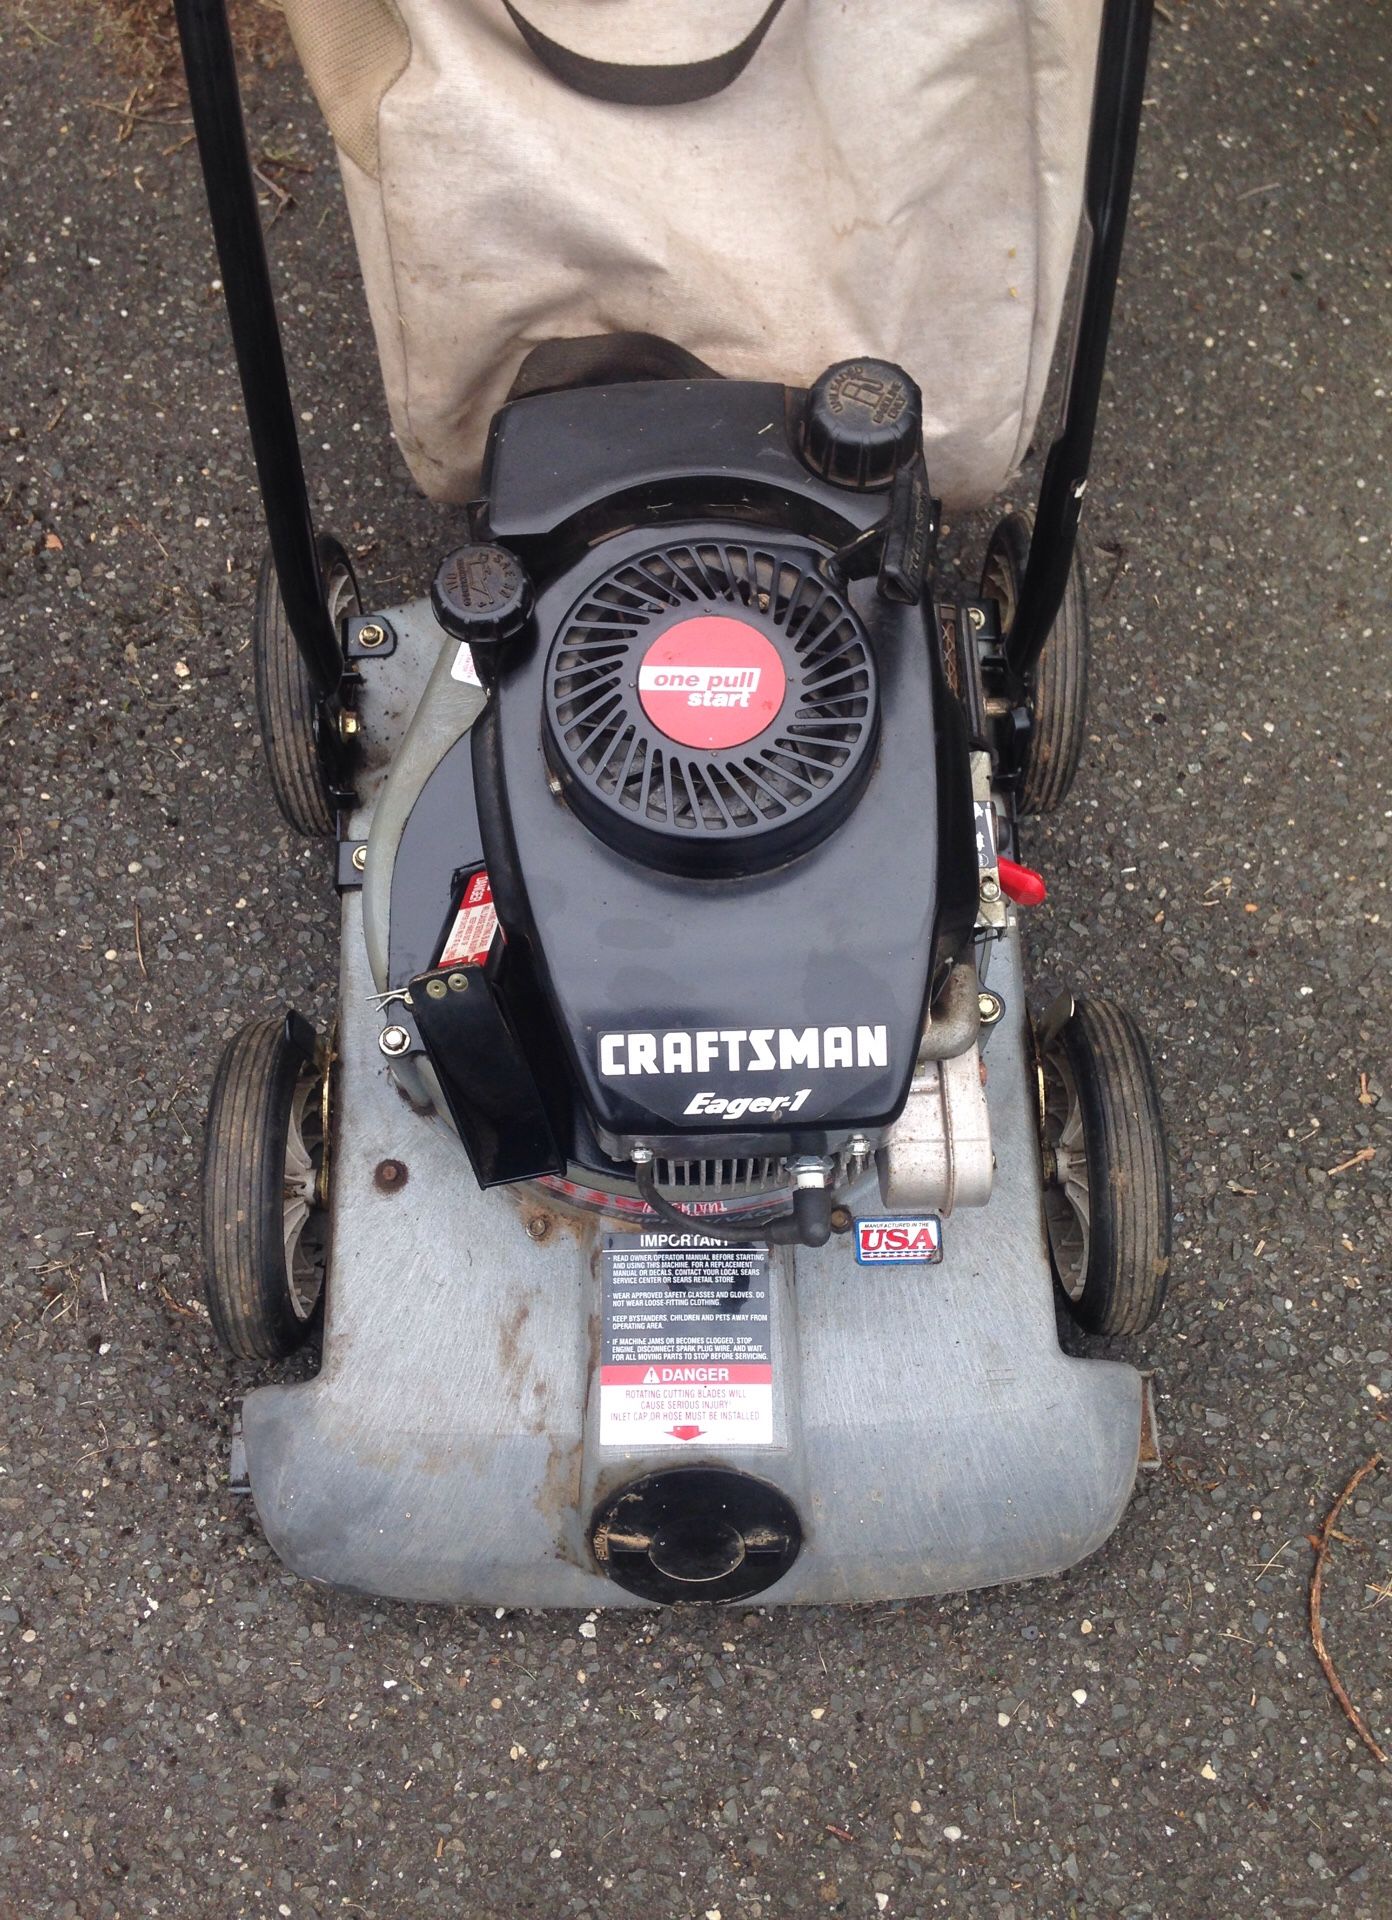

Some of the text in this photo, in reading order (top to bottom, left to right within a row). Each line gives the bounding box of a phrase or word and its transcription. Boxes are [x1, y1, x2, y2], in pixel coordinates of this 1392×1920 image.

[829, 366, 863, 413] UNLEADED
[653, 671, 754, 691] one pull
[687, 690, 751, 708] start
[600, 1025, 888, 1076] CRAFTSMAN
[683, 1088, 812, 1121] Eager-1
[861, 1228, 937, 1251] USA
[676, 1337, 704, 1345] BECOMES
[638, 1353, 662, 1361] MOVING
[662, 1368, 729, 1382] DANGER
[625, 1389, 746, 1398] ROTATING CUTTING BLADES WILL
[641, 1401, 664, 1409] CAUSE
[667, 1400, 699, 1409] SERIOUS
[611, 1413, 631, 1421] INLET
[663, 1412, 682, 1421] HOSE
[685, 1412, 706, 1420] MUST
[709, 1412, 717, 1420] BE
[721, 1411, 760, 1420] INSTALLED
